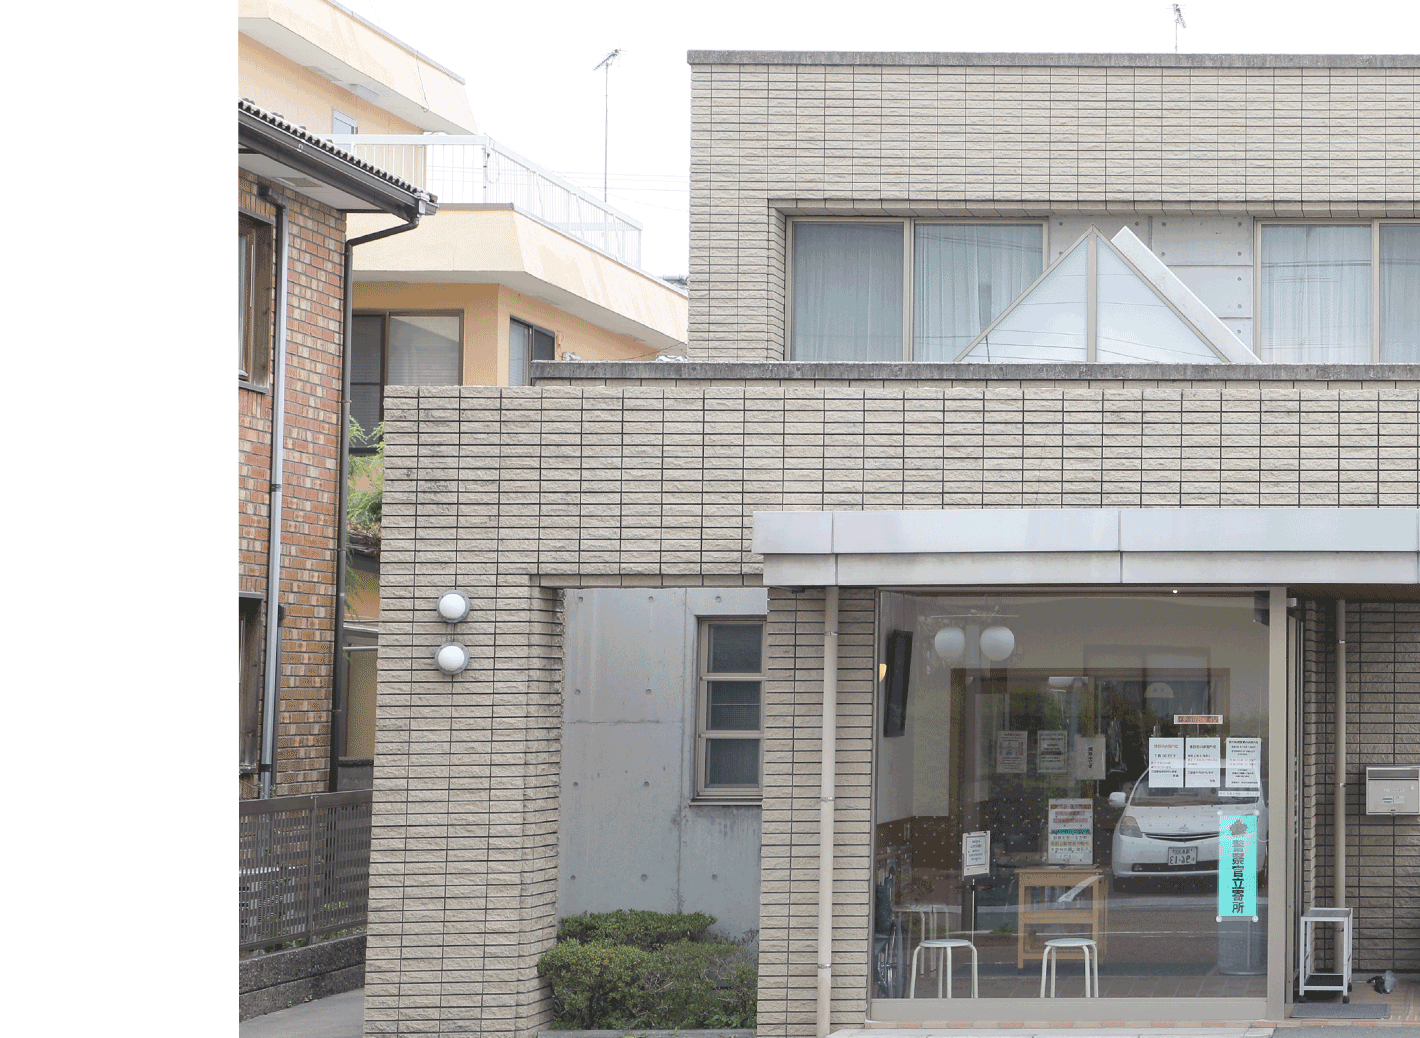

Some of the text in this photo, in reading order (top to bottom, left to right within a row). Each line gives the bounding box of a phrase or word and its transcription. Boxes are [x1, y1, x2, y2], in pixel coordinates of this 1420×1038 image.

[1231, 839, 1245, 914] 警察官立寄所
